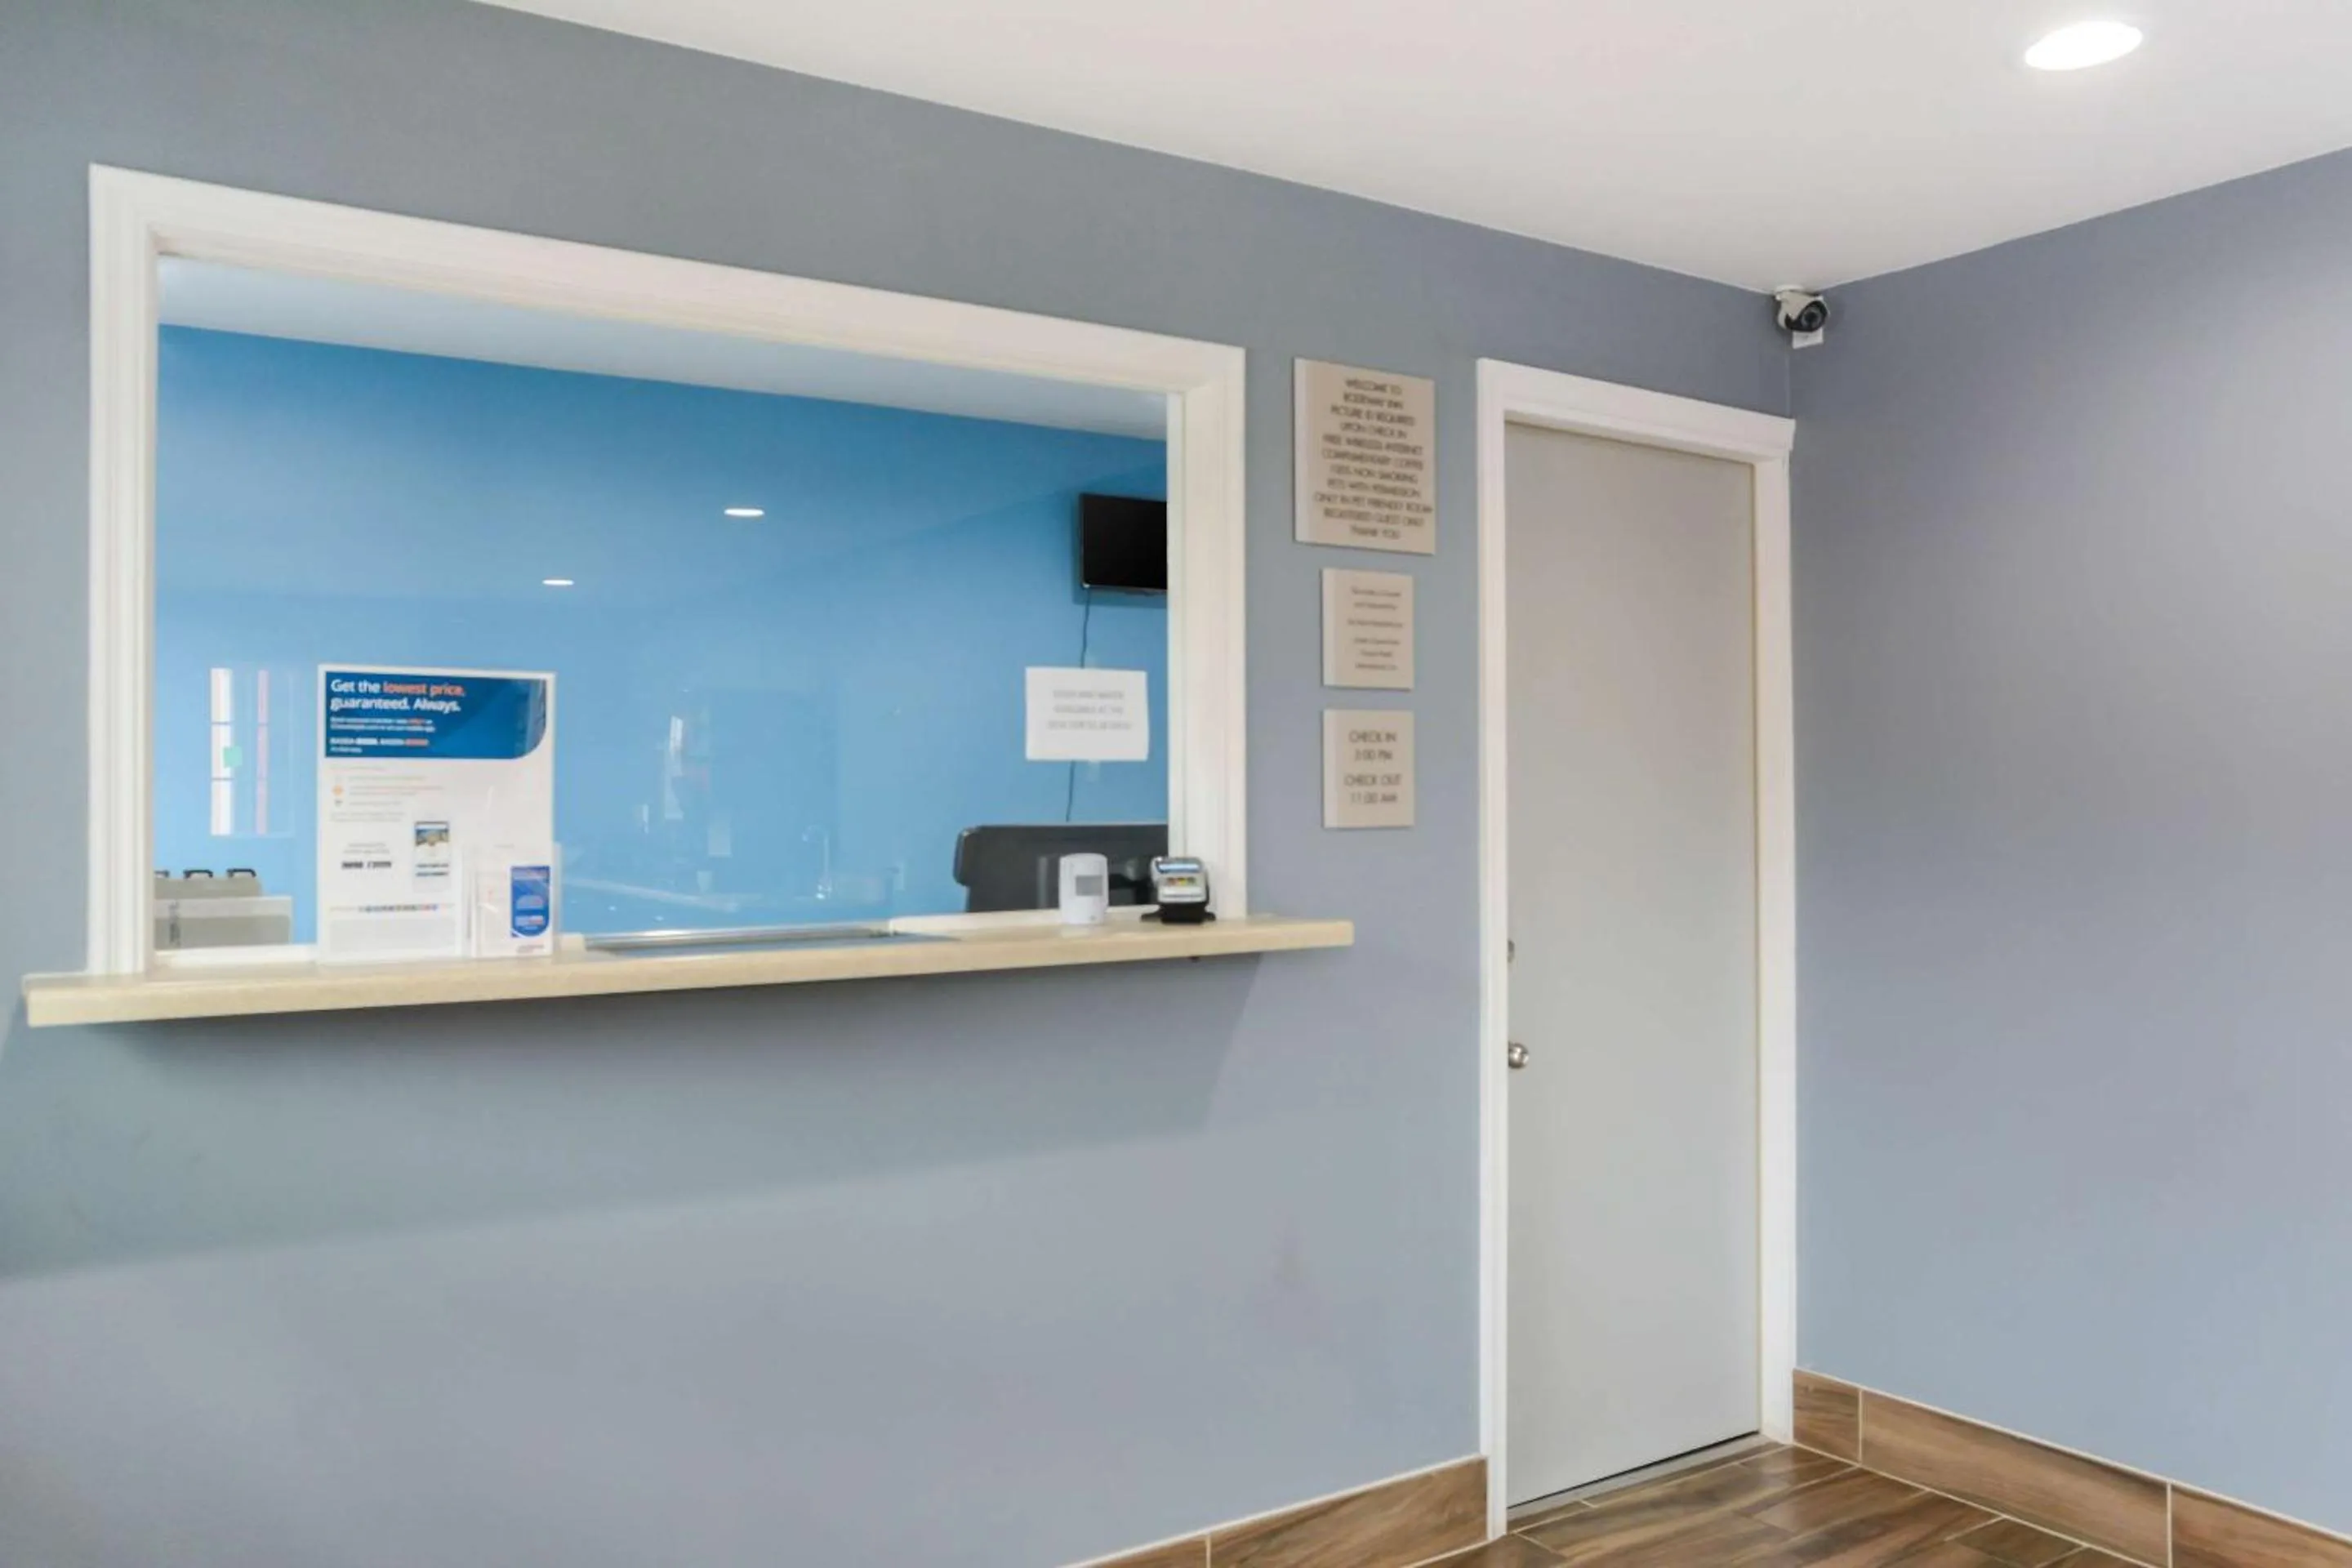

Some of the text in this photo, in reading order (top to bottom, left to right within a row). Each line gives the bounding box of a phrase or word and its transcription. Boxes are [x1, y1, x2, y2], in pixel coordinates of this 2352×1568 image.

[331, 679, 354, 693] Get
[359, 679, 381, 693] the
[383, 681, 427, 694] lowest
[330, 697, 410, 711] guaranteed.
[1348, 728, 1397, 743] CHECK IN
[1343, 773, 1403, 786] CHECK OUT
